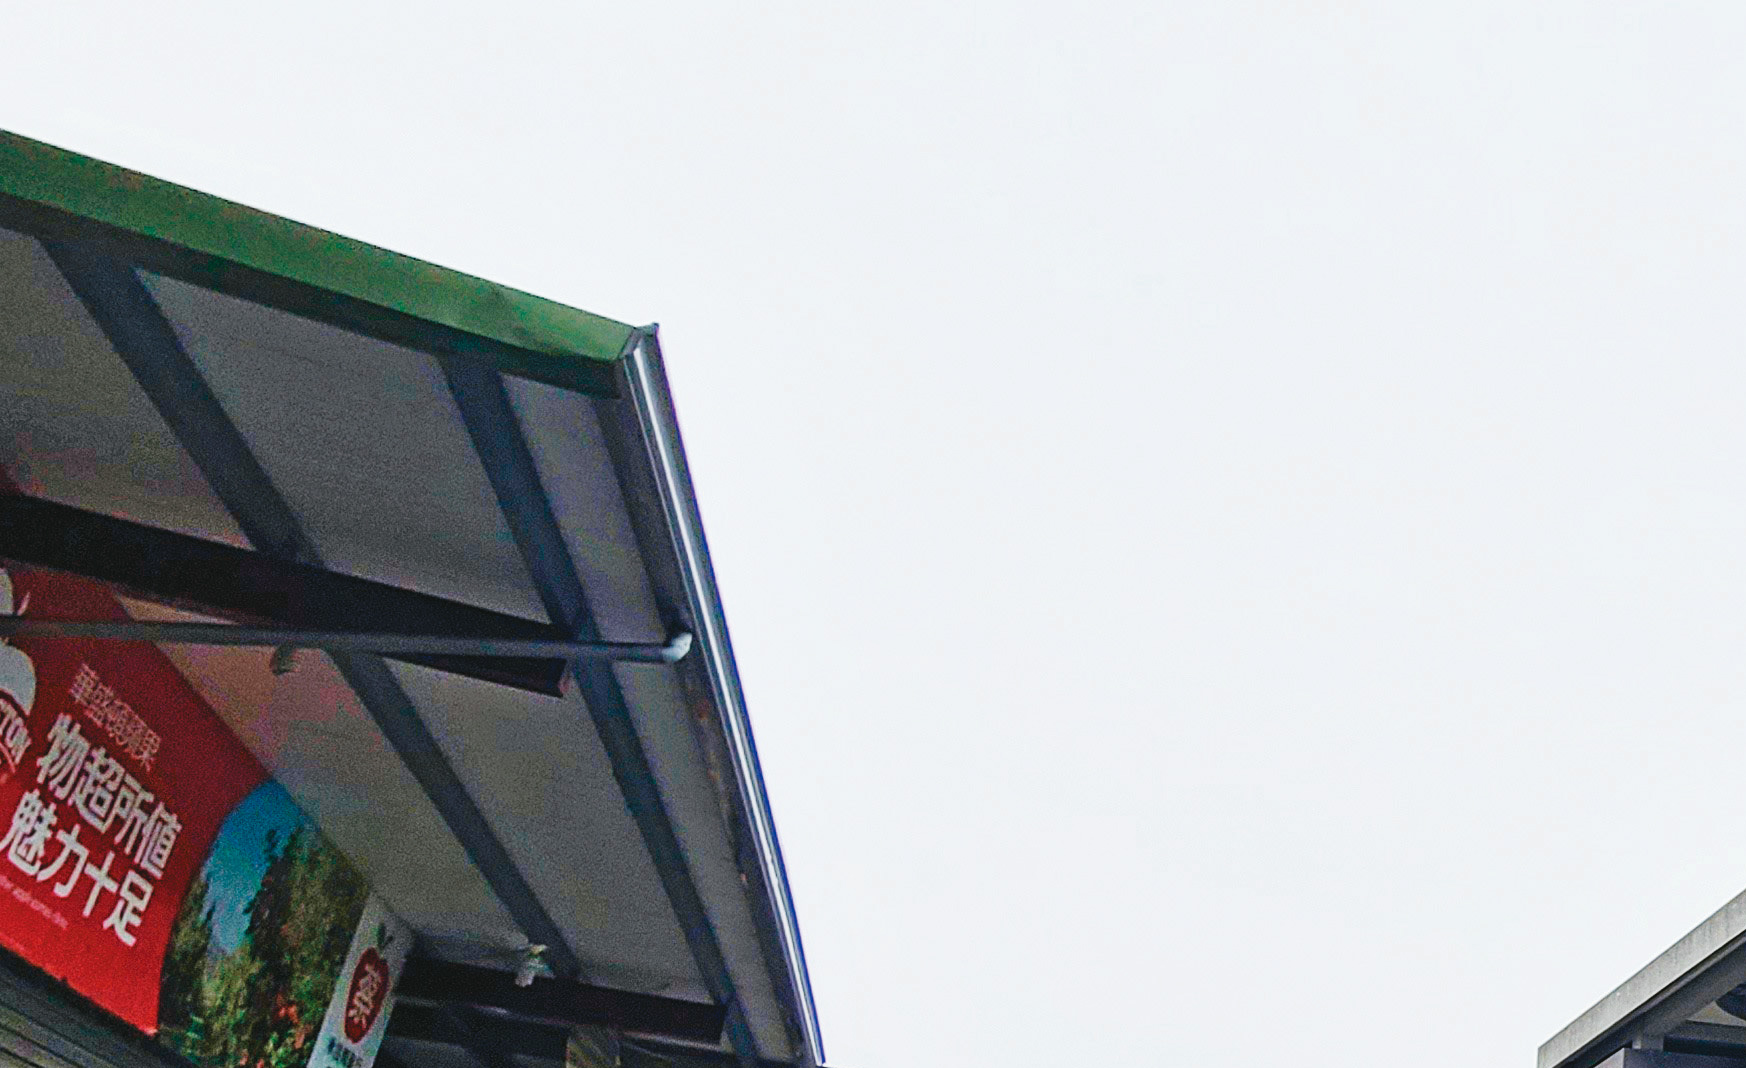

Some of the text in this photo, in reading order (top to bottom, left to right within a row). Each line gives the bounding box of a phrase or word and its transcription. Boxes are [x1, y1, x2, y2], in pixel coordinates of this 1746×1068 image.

[0, 789, 153, 947] 魅力十足
[36, 712, 182, 880] 物超所值
